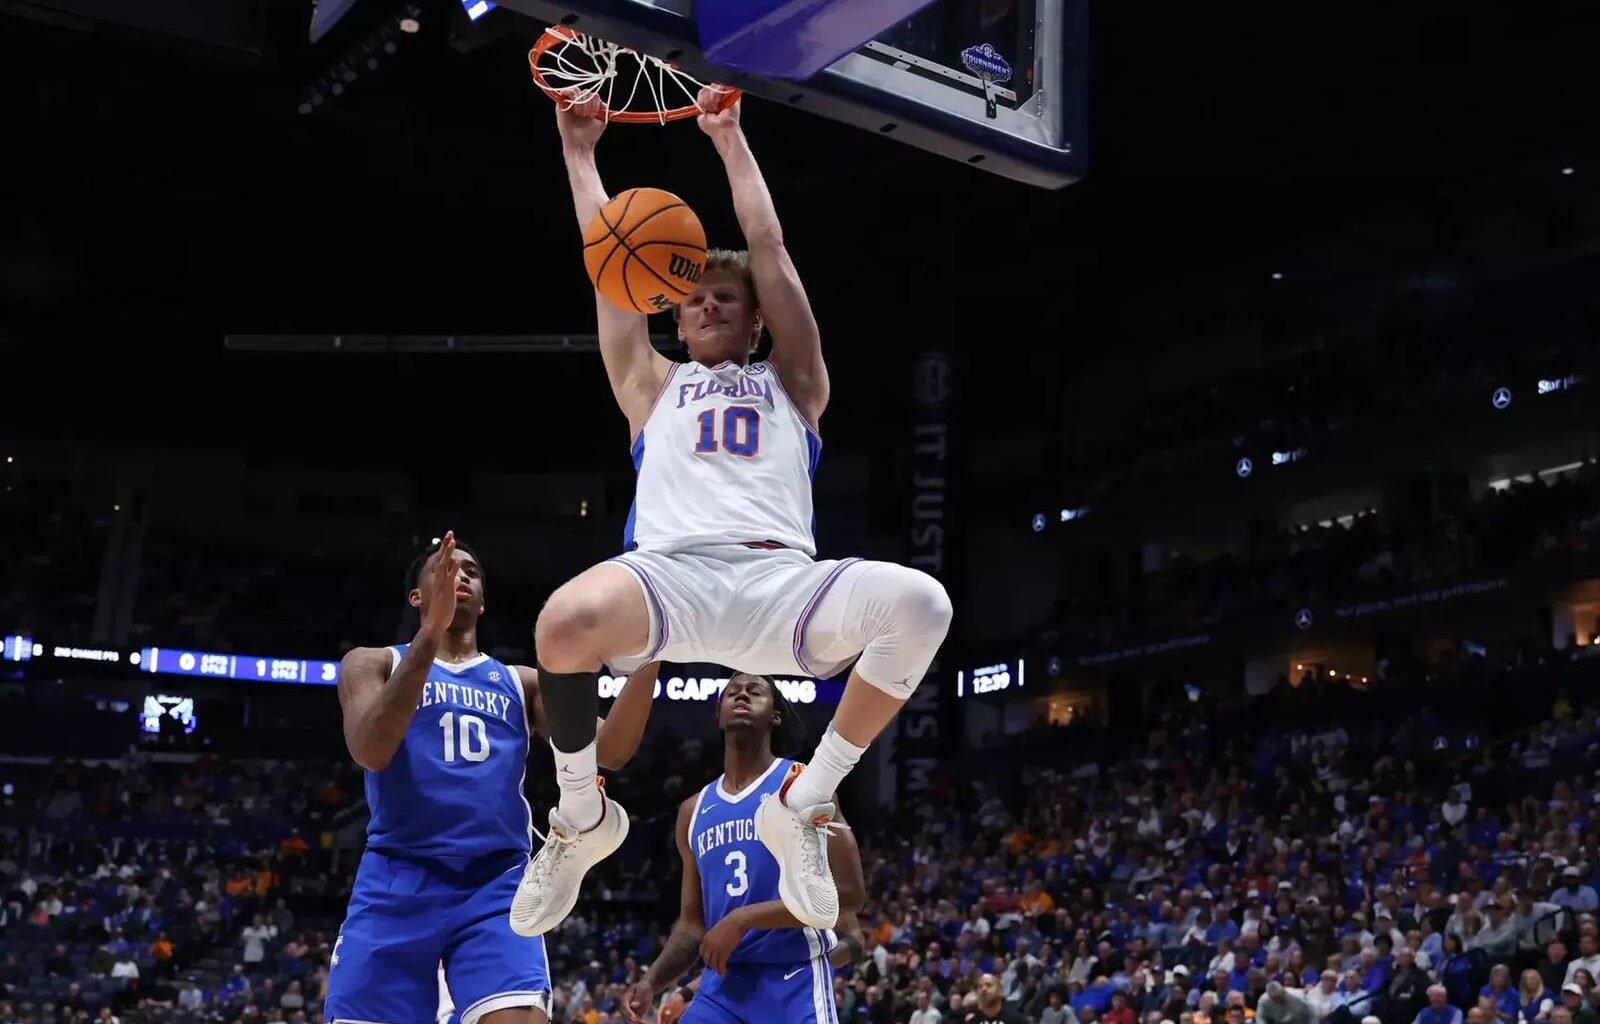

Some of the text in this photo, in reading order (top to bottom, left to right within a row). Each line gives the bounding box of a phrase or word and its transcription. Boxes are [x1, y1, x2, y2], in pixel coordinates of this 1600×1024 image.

[965, 53, 1010, 74] TOURNAMENT
[668, 253, 702, 284] Wil
[694, 404, 760, 458] 10
[179, 653, 196, 671] 0
[256, 660, 266, 677] 1
[321, 663, 336, 681] 3
[416, 681, 511, 721] ENTUCKY
[438, 711, 491, 762] 10
[697, 818, 761, 859] KENTUC
[724, 850, 749, 897] 3
